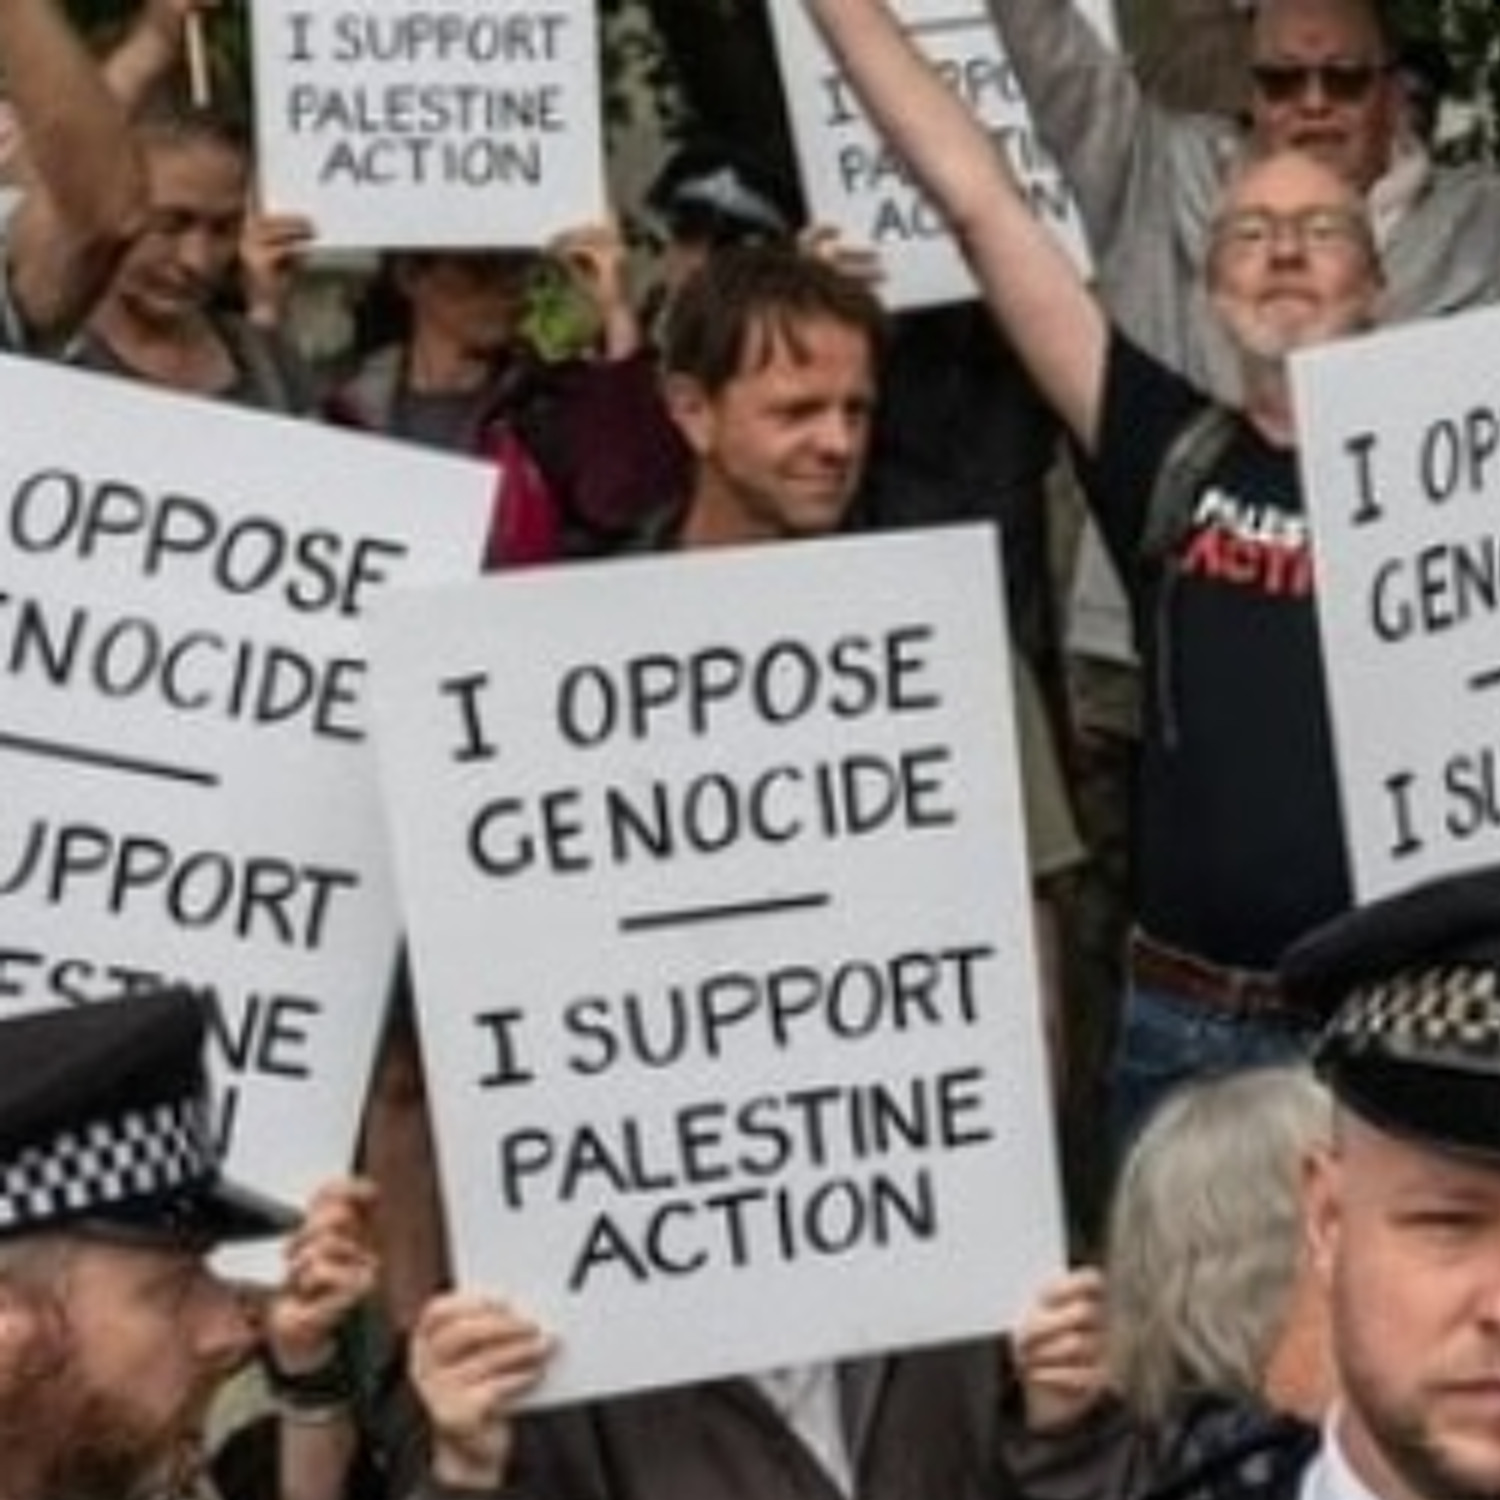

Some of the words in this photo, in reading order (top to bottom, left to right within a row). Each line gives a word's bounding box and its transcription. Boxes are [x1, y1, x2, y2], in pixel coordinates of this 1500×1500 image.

[286, 11, 316, 64] I
[332, 11, 569, 65] SUPPORT
[286, 83, 565, 136] PALESTINE
[318, 135, 543, 188] ACTION
[1343, 431, 1384, 528] I
[0, 590, 369, 745] NOCIDE
[440, 672, 498, 764] I
[555, 623, 941, 750] OPPOSE
[466, 744, 957, 879] GENOCIDE
[1383, 770, 1424, 860] I
[473, 1007, 536, 1090] I
[562, 943, 996, 1077] SUPPORT
[499, 1065, 995, 1211] PALESTINE
[567, 1168, 938, 1293] ACTION
